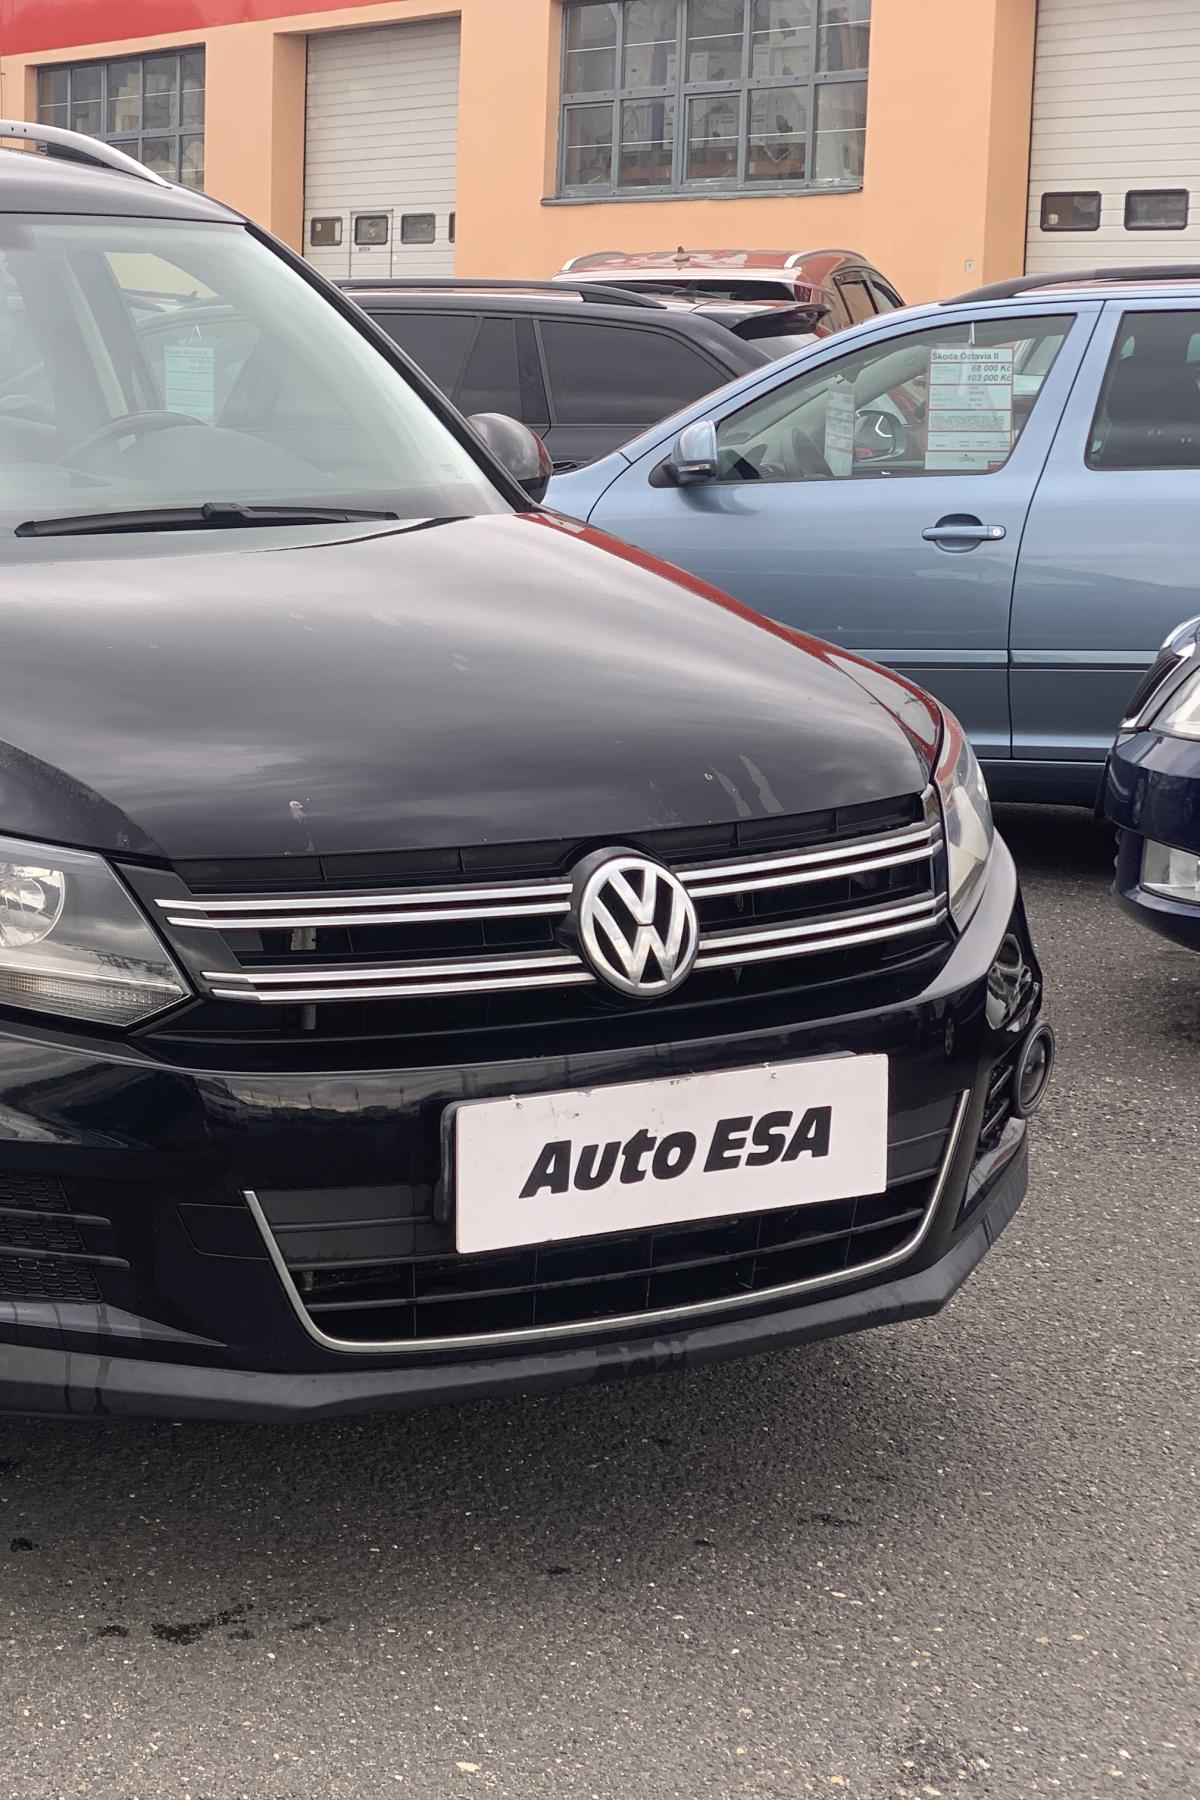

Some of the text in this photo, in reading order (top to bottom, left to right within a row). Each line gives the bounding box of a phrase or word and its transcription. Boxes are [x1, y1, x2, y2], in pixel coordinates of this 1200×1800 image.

[960, 352, 992, 360] Octavia
[983, 364, 999, 372] 000
[983, 374, 999, 382] 000
[584, 860, 694, 992] VW
[518, 1105, 833, 1200] Auto ESA
